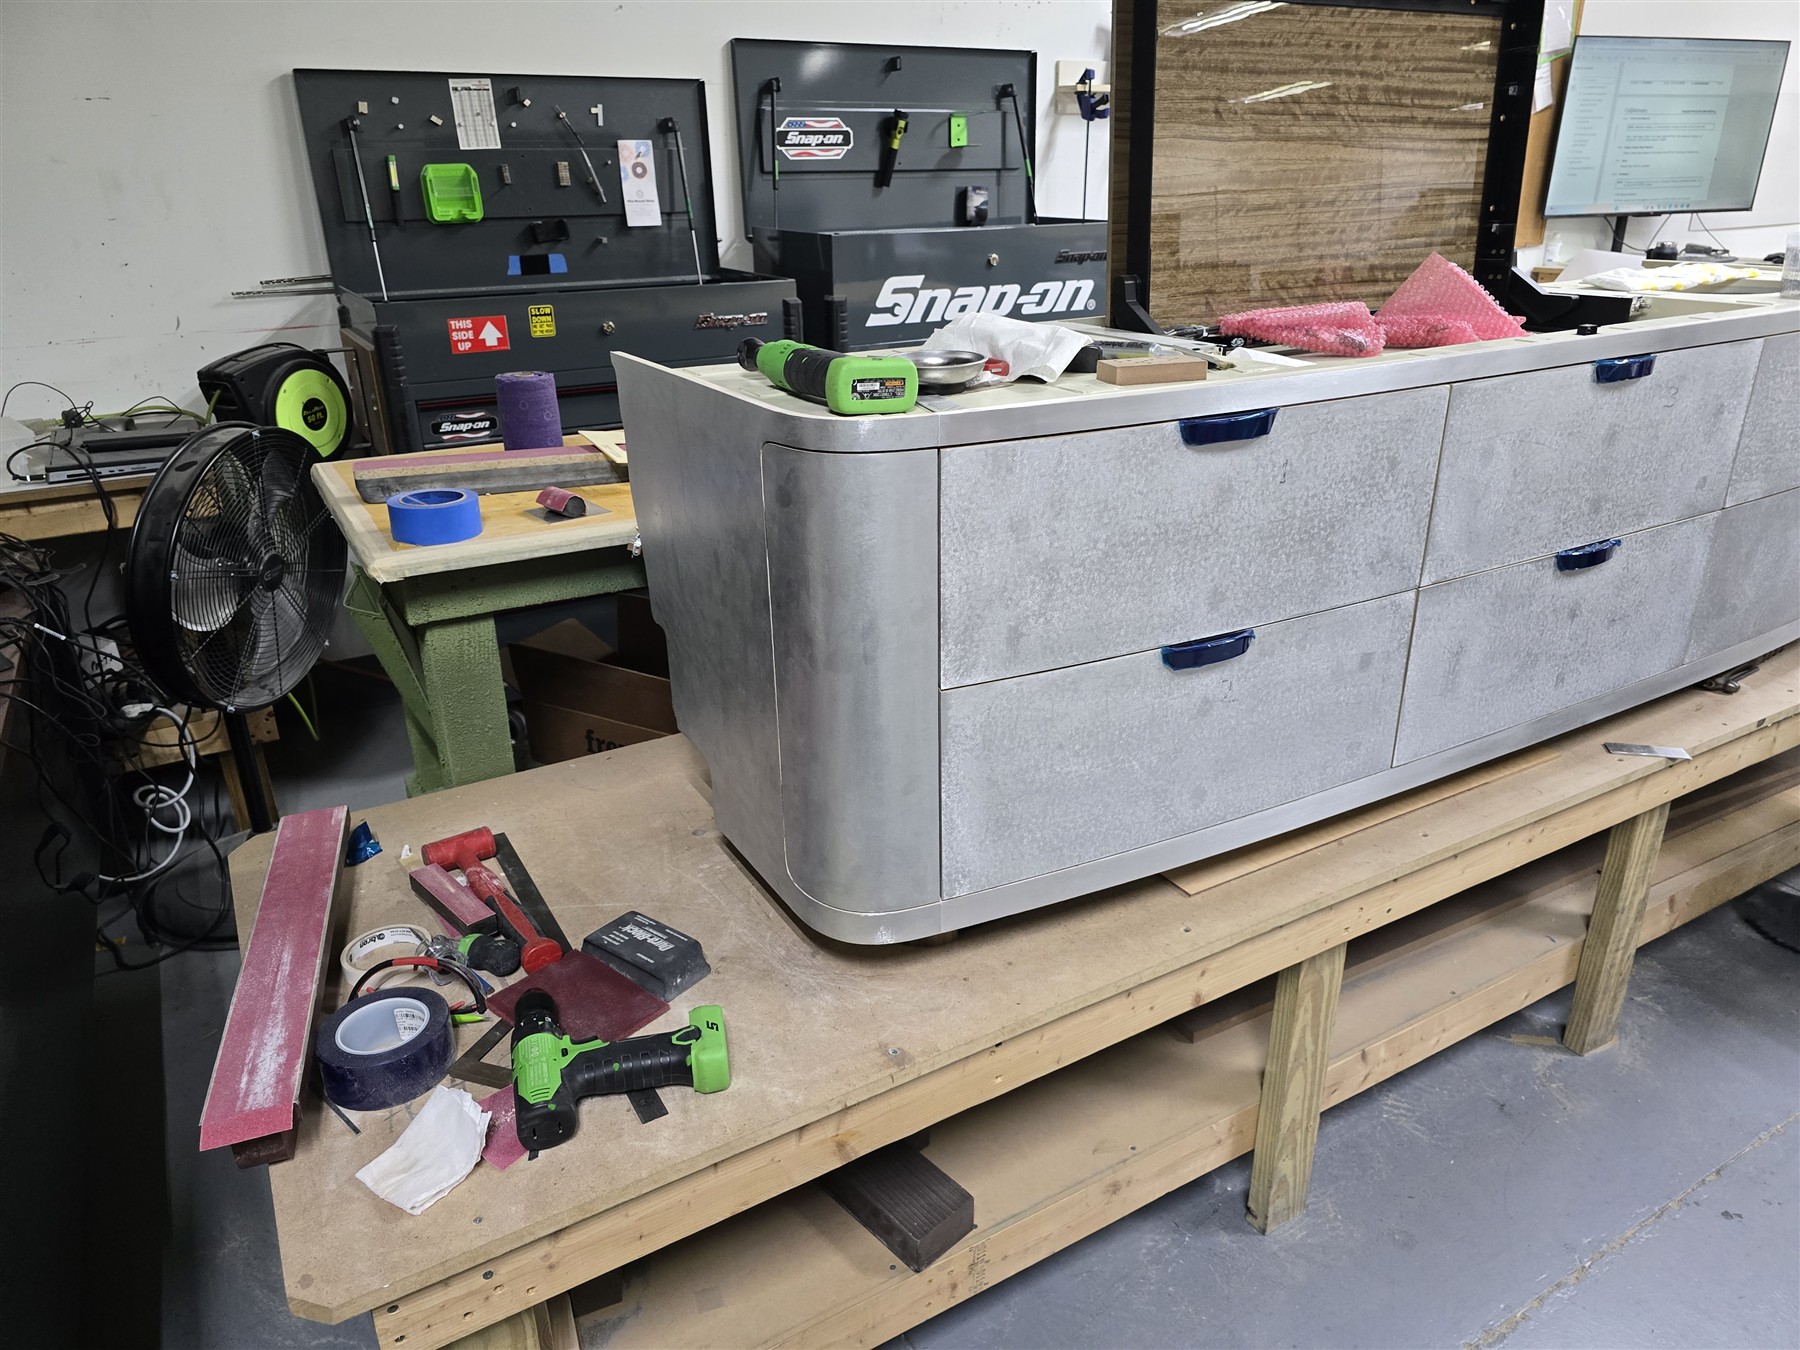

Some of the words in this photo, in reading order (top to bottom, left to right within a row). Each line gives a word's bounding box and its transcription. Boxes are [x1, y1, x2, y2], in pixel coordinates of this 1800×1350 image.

[784, 131, 844, 147] Snap-on
[865, 274, 1095, 328] Snap-on
[531, 307, 551, 315] SLOW
[532, 315, 552, 323] DOWN
[449, 320, 472, 329] THIS
[451, 330, 474, 341] SIDE
[457, 341, 472, 351] UP
[439, 420, 491, 433] Snap-on
